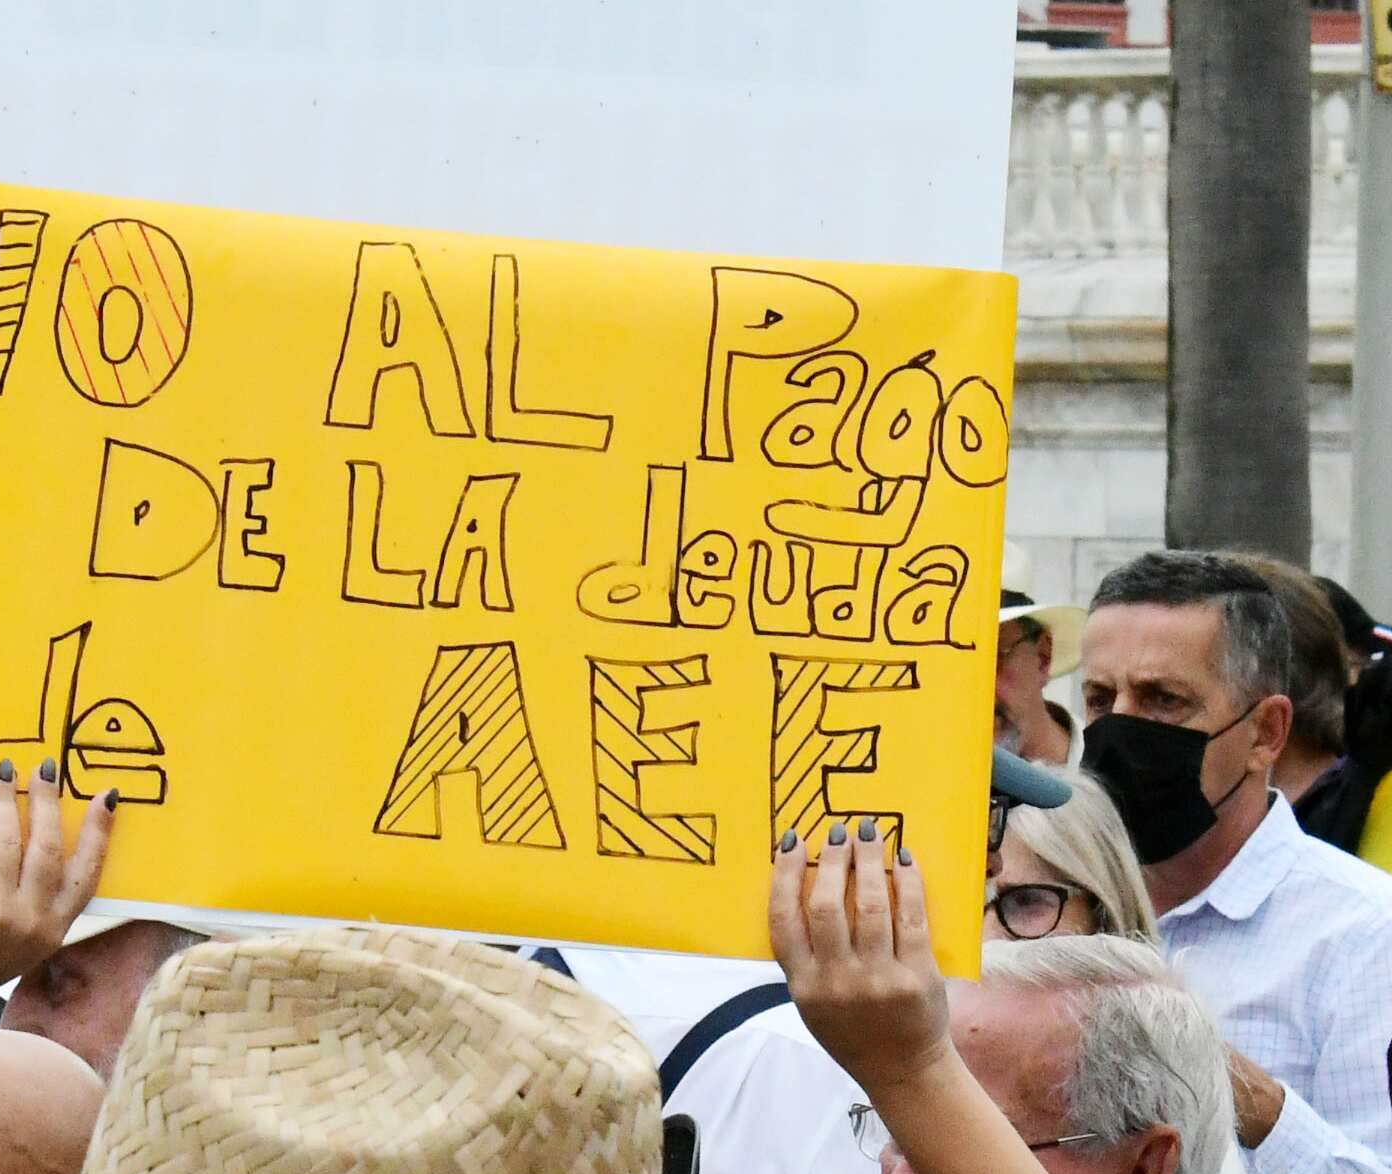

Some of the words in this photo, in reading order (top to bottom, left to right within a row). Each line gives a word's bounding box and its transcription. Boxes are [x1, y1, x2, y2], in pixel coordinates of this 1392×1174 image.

[323, 241, 615, 453] AL
[88, 437, 287, 593] DE
[340, 459, 521, 613] LA
[576, 462, 976, 650] deuda
[373, 640, 921, 868] AEE
